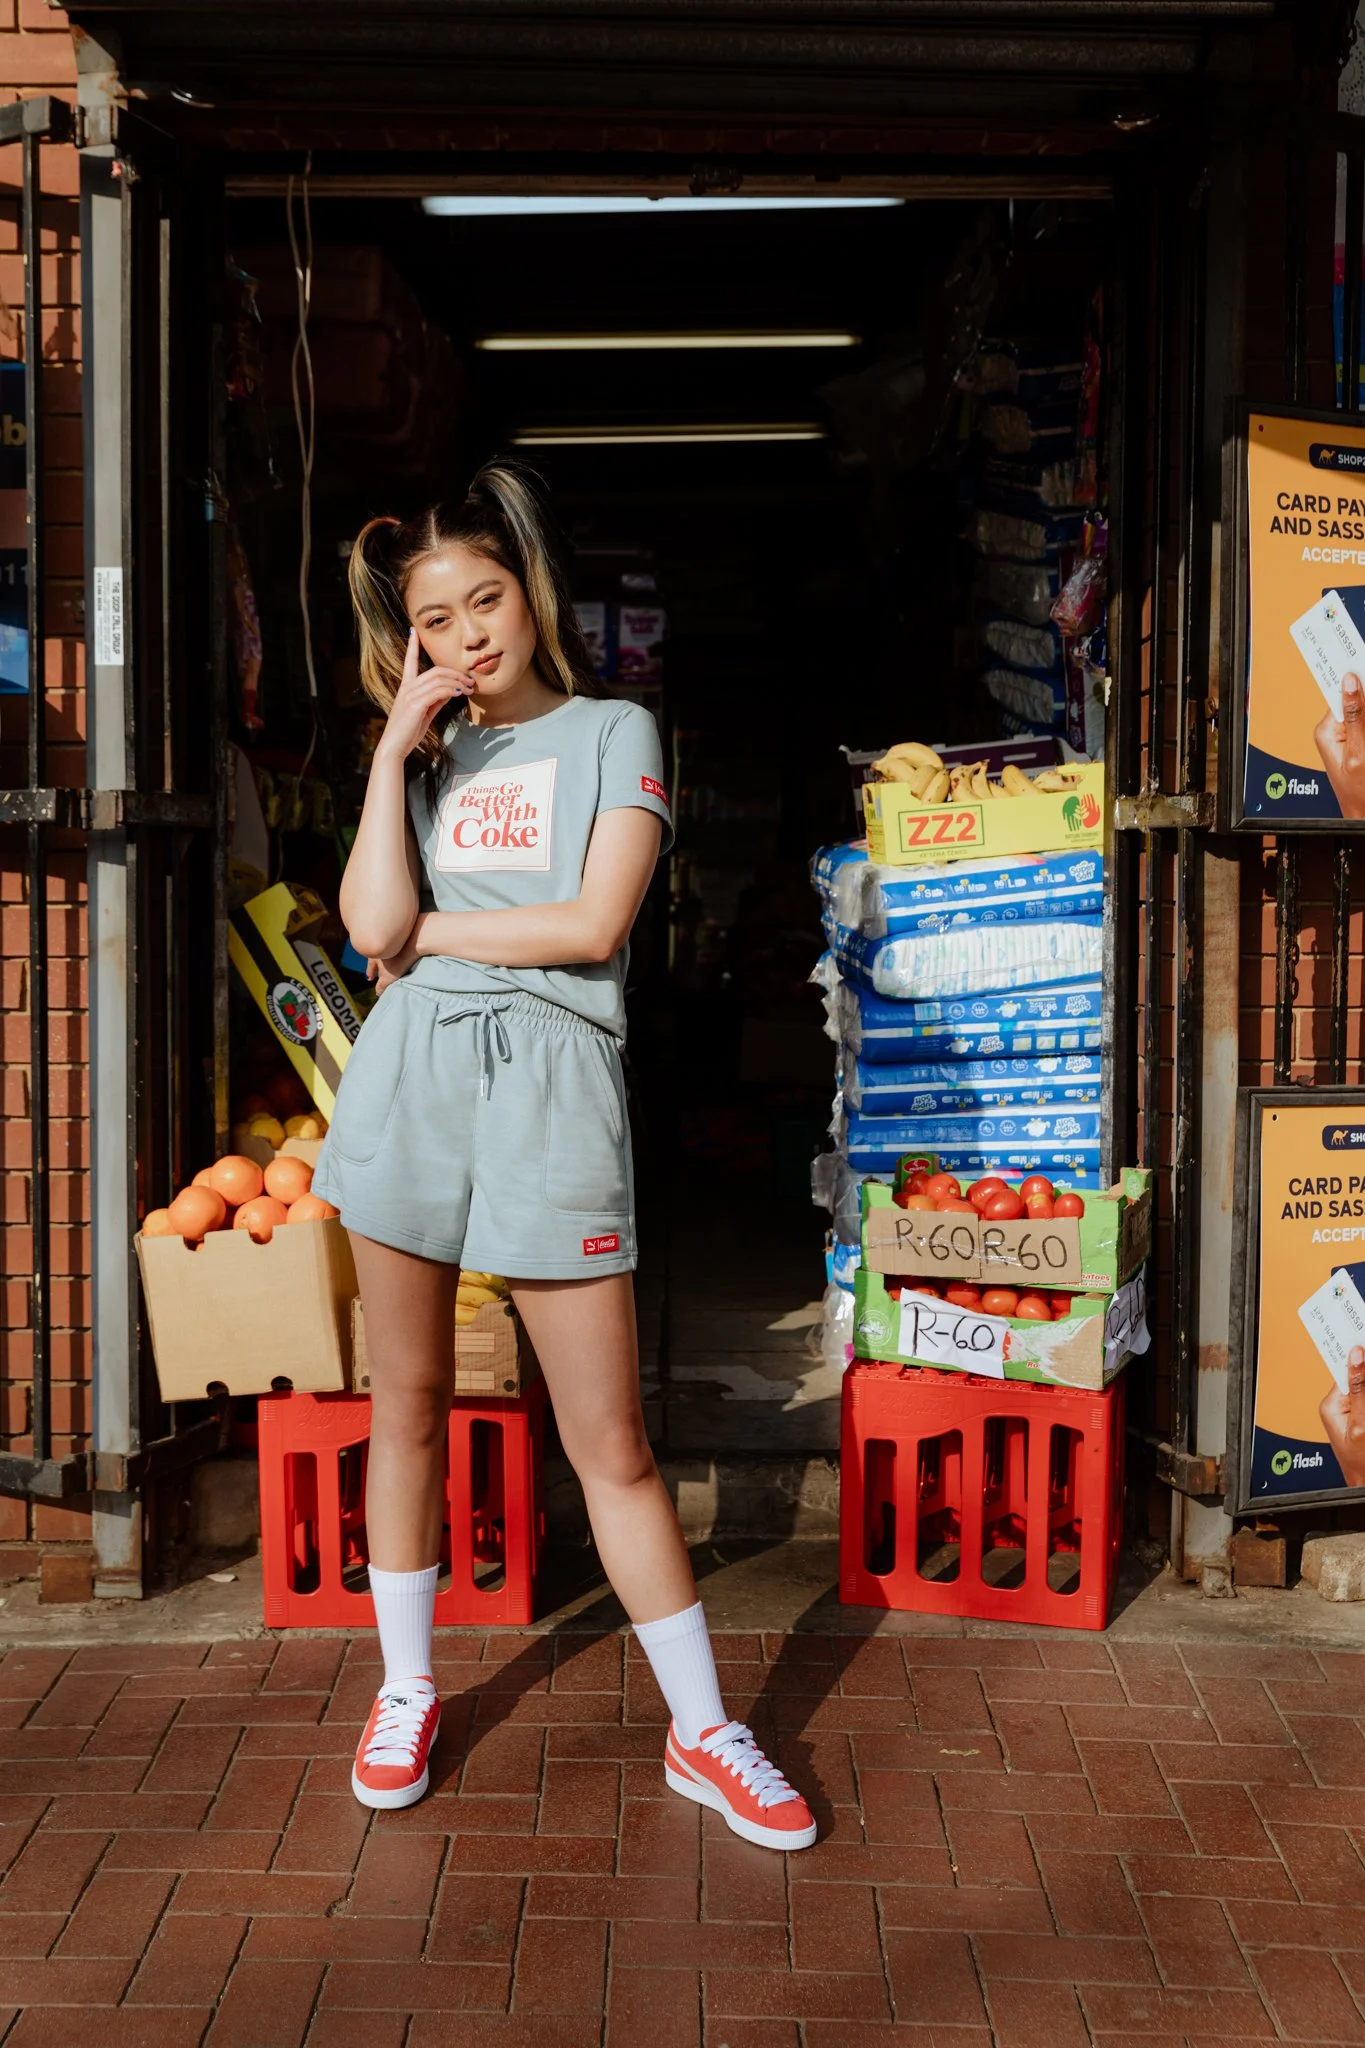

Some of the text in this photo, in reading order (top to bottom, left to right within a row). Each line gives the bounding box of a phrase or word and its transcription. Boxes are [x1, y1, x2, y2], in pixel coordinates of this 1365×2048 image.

[1276, 492, 1331, 514] CARD
[1270, 515, 1312, 536] AND
[1335, 623, 1357, 657] sassa
[466, 781, 524, 796] Things Go
[1287, 778, 1319, 796] flash
[458, 793, 521, 808] Better
[482, 802, 538, 823] With
[453, 817, 539, 849] Coke
[907, 812, 977, 846] ZZ2
[1070, 862, 1095, 876] Super
[1076, 870, 1094, 882] Soft
[290, 979, 323, 1031] LEBOMBO
[310, 960, 361, 1039] LEBOMB
[1065, 1001, 1091, 1013] Super
[1067, 995, 1086, 1005] Soft
[1054, 1123, 1081, 1136] Super
[1056, 1117, 1075, 1128] Soft
[1288, 1176, 1342, 1196] CARD
[1281, 1200, 1323, 1220] AND
[895, 1217, 975, 1261] R-60
[983, 1227, 1068, 1271] R-60
[1343, 1299, 1364, 1332] sassa
[904, 1301, 996, 1357] R-60
[1292, 1451, 1324, 1469] flash
